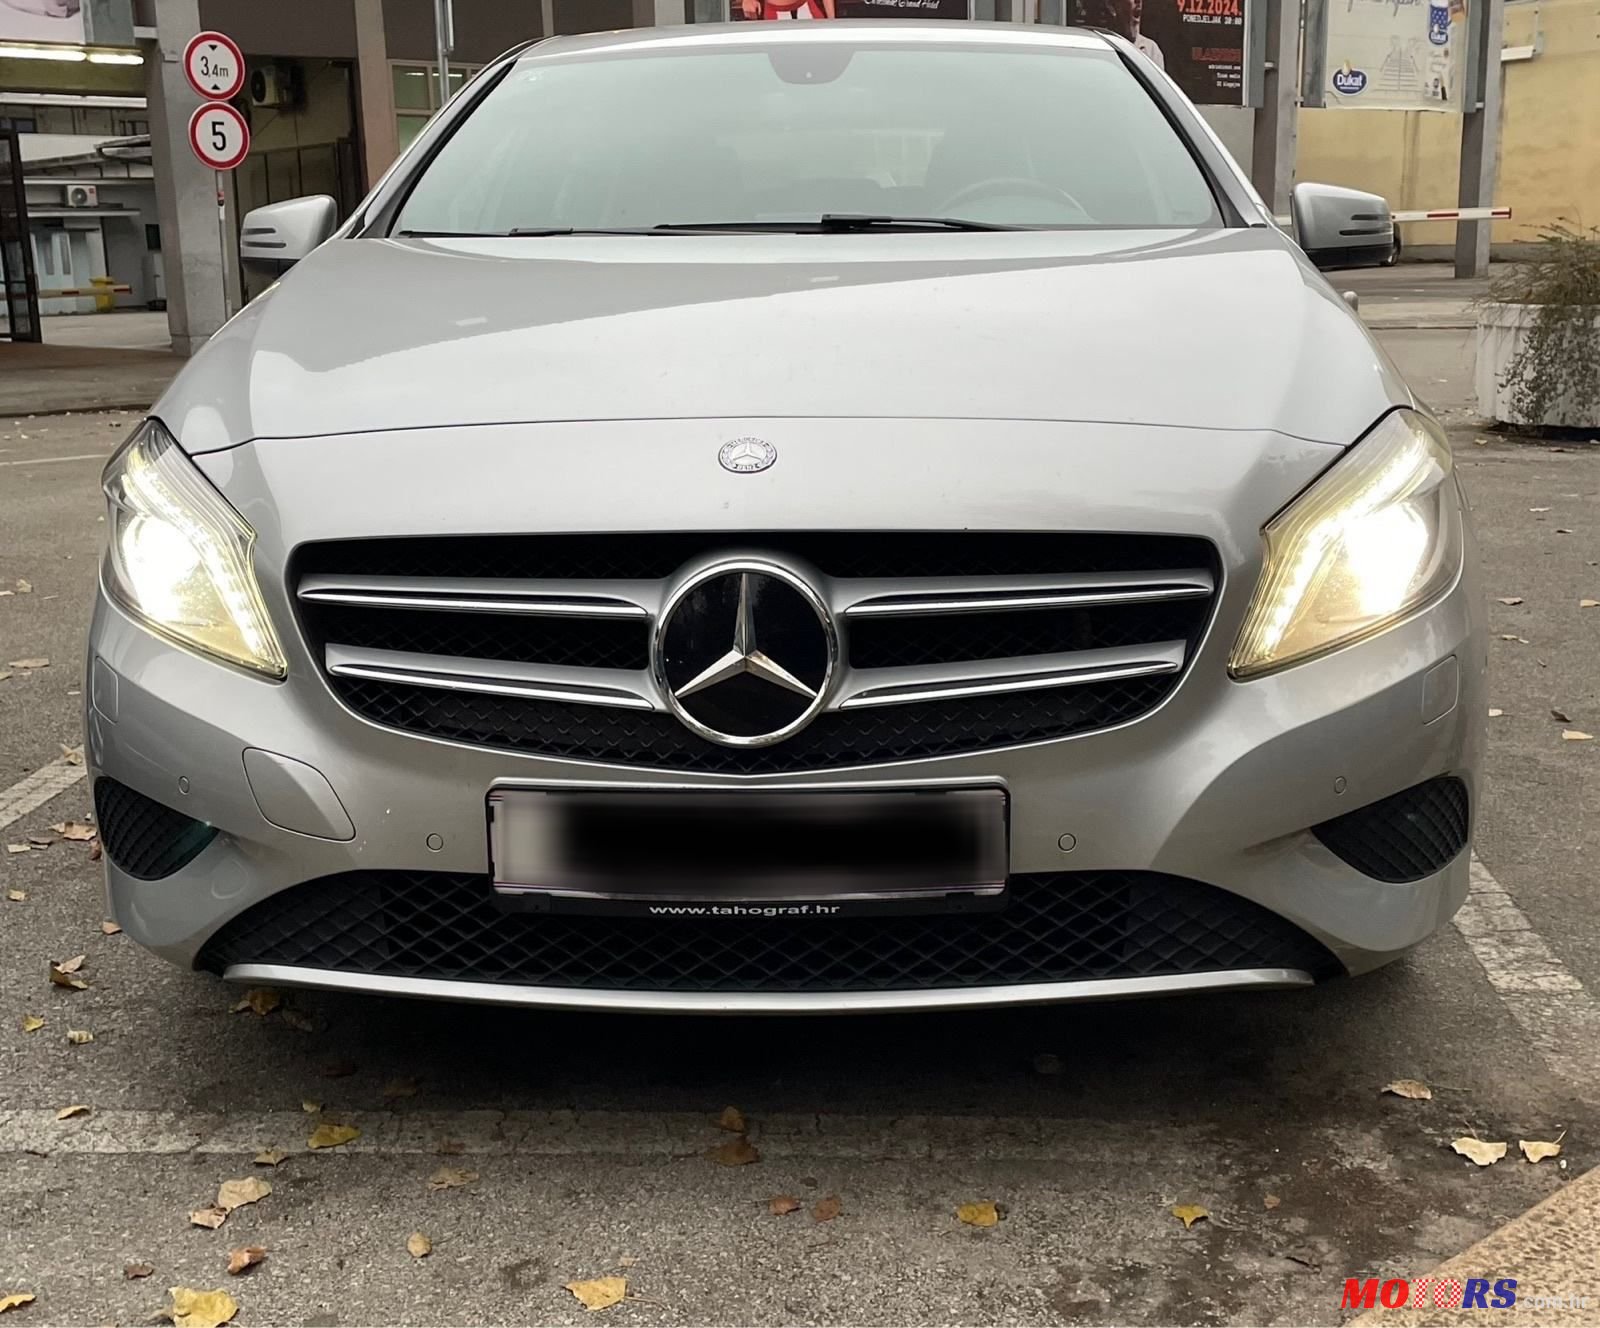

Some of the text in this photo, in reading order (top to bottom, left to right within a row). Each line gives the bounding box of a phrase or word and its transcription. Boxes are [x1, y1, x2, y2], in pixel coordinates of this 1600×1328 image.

[1177, 0, 1242, 16] 9.12.2024.
[1336, 73, 1363, 87] Dukat
[211, 121, 227, 152] 5
[649, 905, 841, 917] www.tahograf.hr
